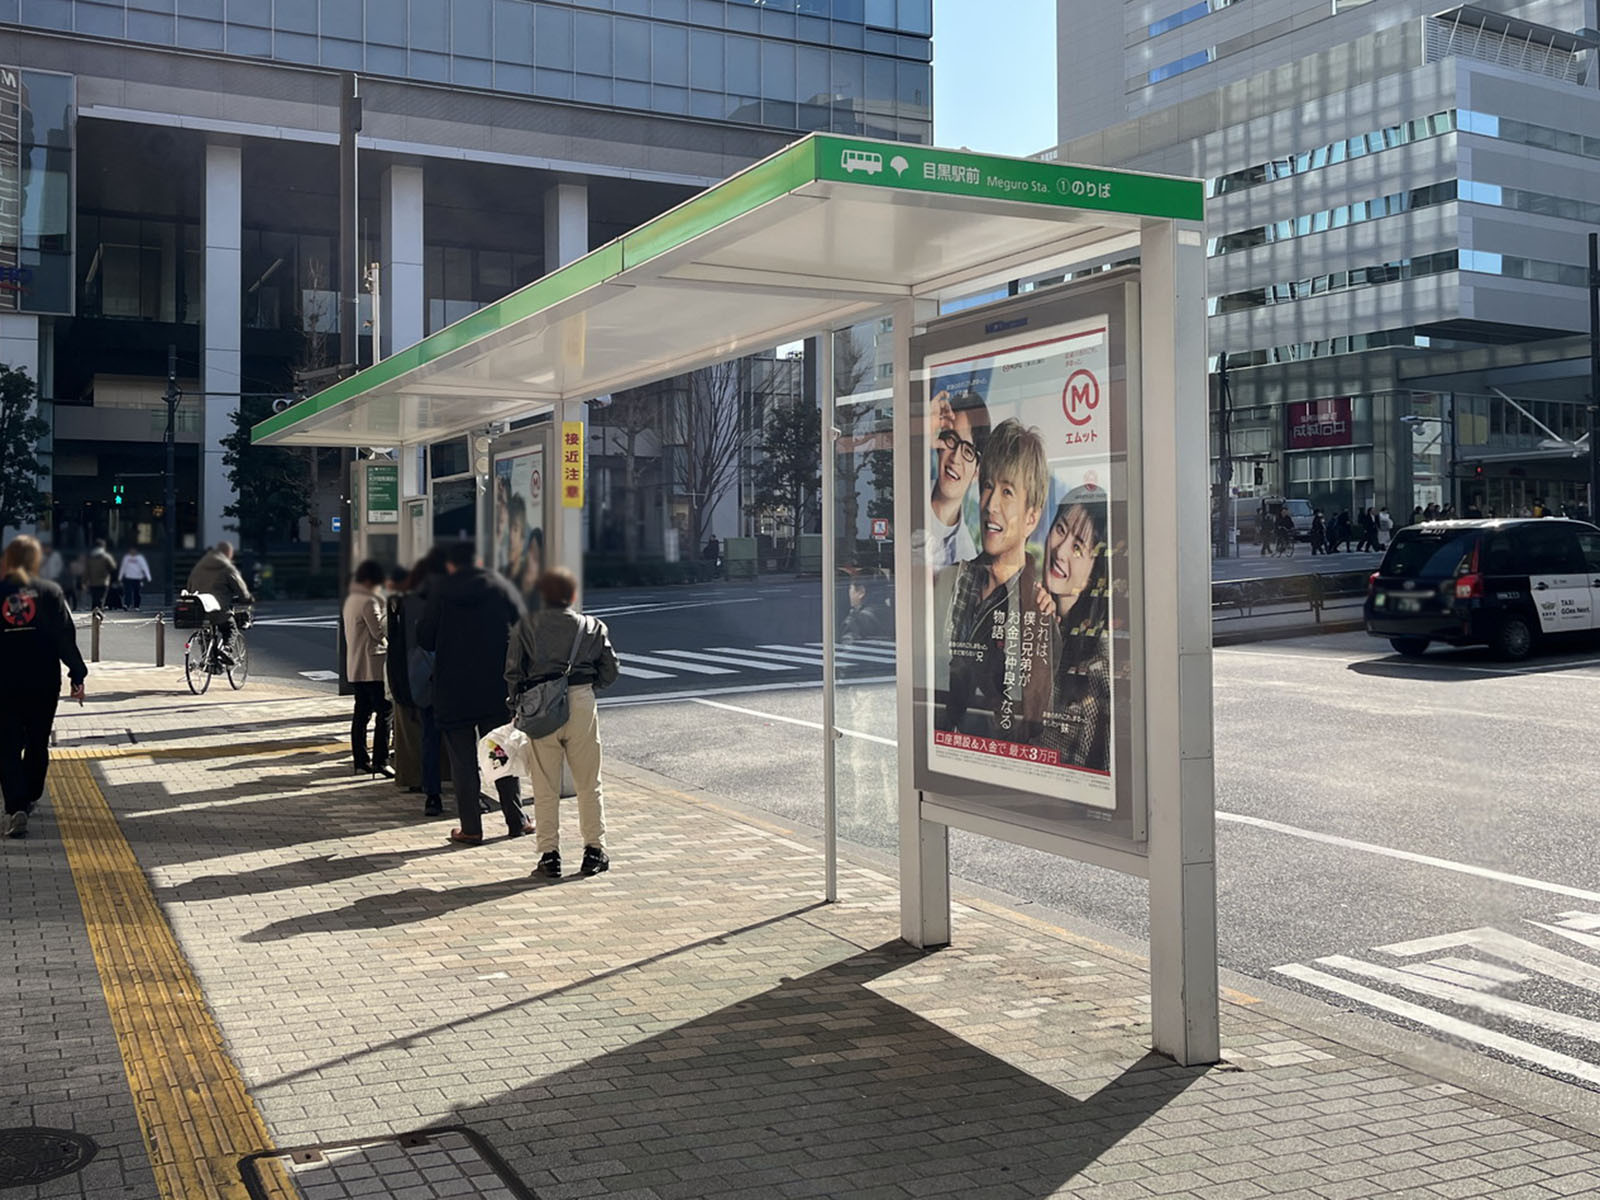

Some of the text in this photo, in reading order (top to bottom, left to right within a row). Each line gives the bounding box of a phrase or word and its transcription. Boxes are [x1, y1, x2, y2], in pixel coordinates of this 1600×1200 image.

[923, 161, 981, 185] 目黒駅前
[986, 175, 1029, 193] Meguro
[1031, 181, 1050, 194] Sta.
[1065, 428, 1098, 445] エムット
[564, 432, 580, 498] 接近注
[991, 609, 1006, 640] 物語
[1018, 611, 1036, 687] 僕ら兄弟が
[1036, 612, 1049, 665] これは、
[999, 610, 1021, 730] お金と仲良くなる
